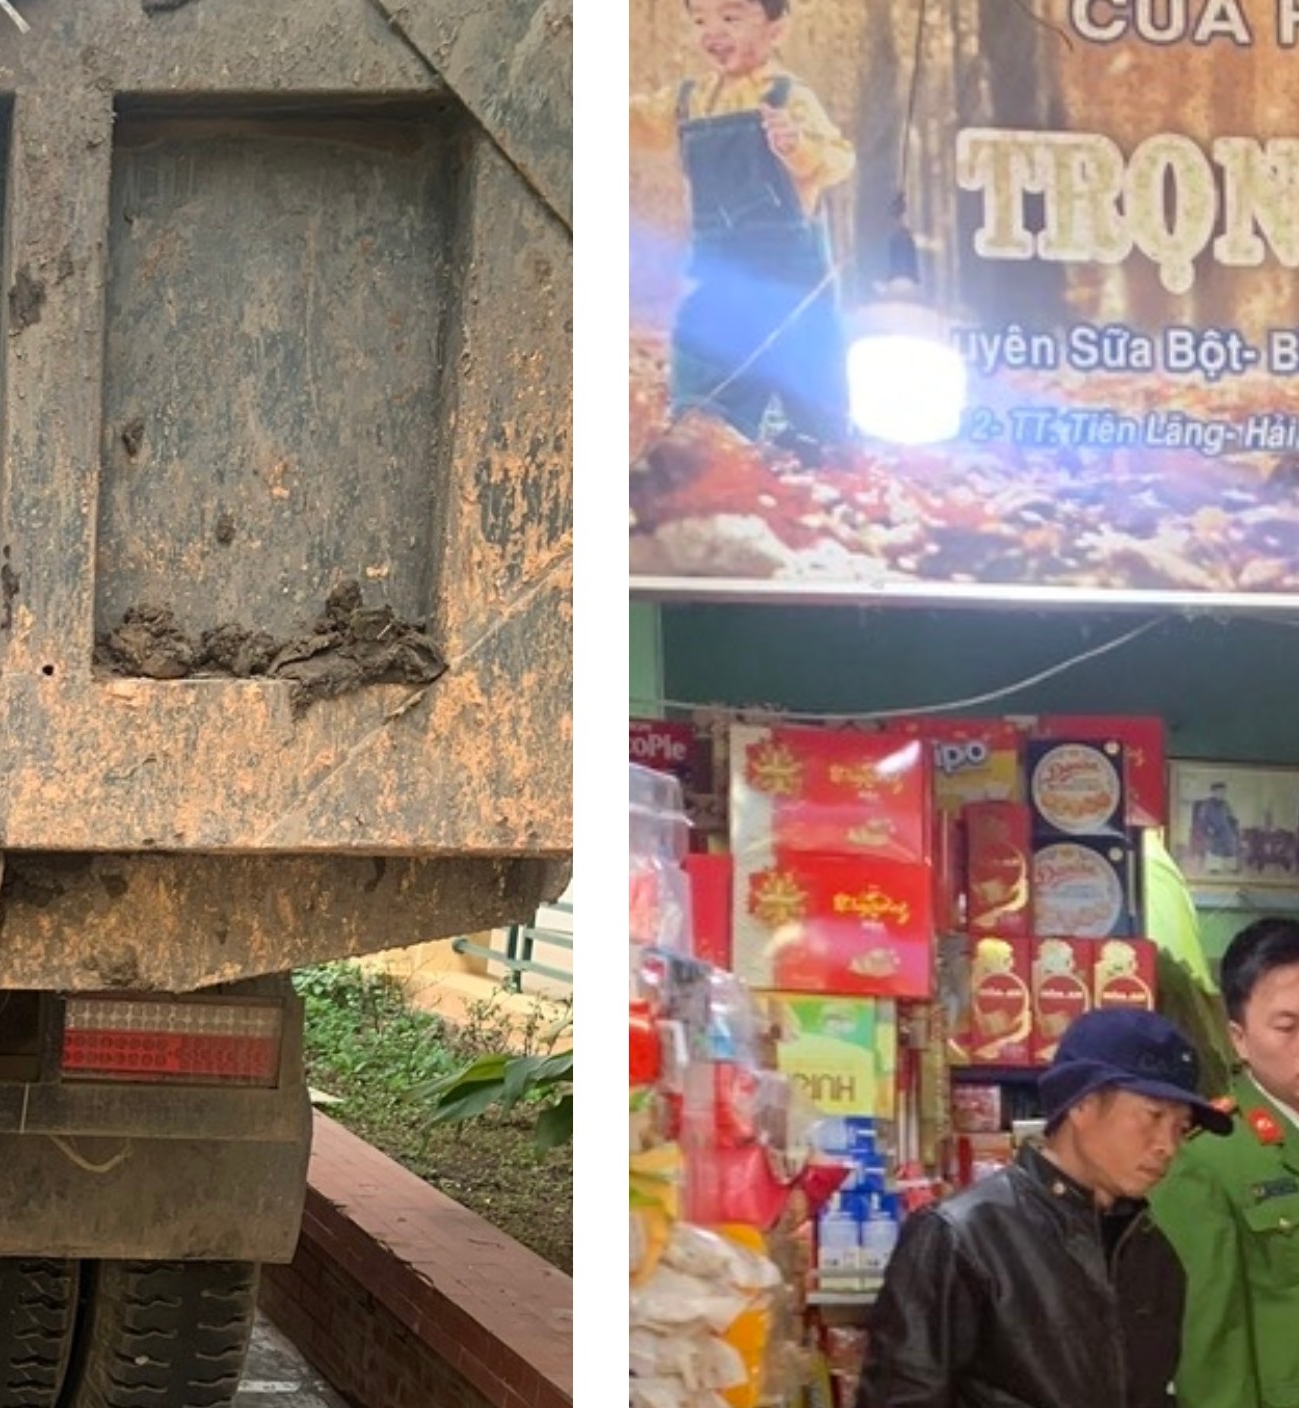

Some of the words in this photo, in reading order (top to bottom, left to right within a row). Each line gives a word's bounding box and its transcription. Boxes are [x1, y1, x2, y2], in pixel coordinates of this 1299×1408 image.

[953, 326, 1056, 373] uyên
[1070, 324, 1152, 369] Sữa
[1167, 329, 1257, 379] Bột-
[1245, 411, 1299, 450] Hải
